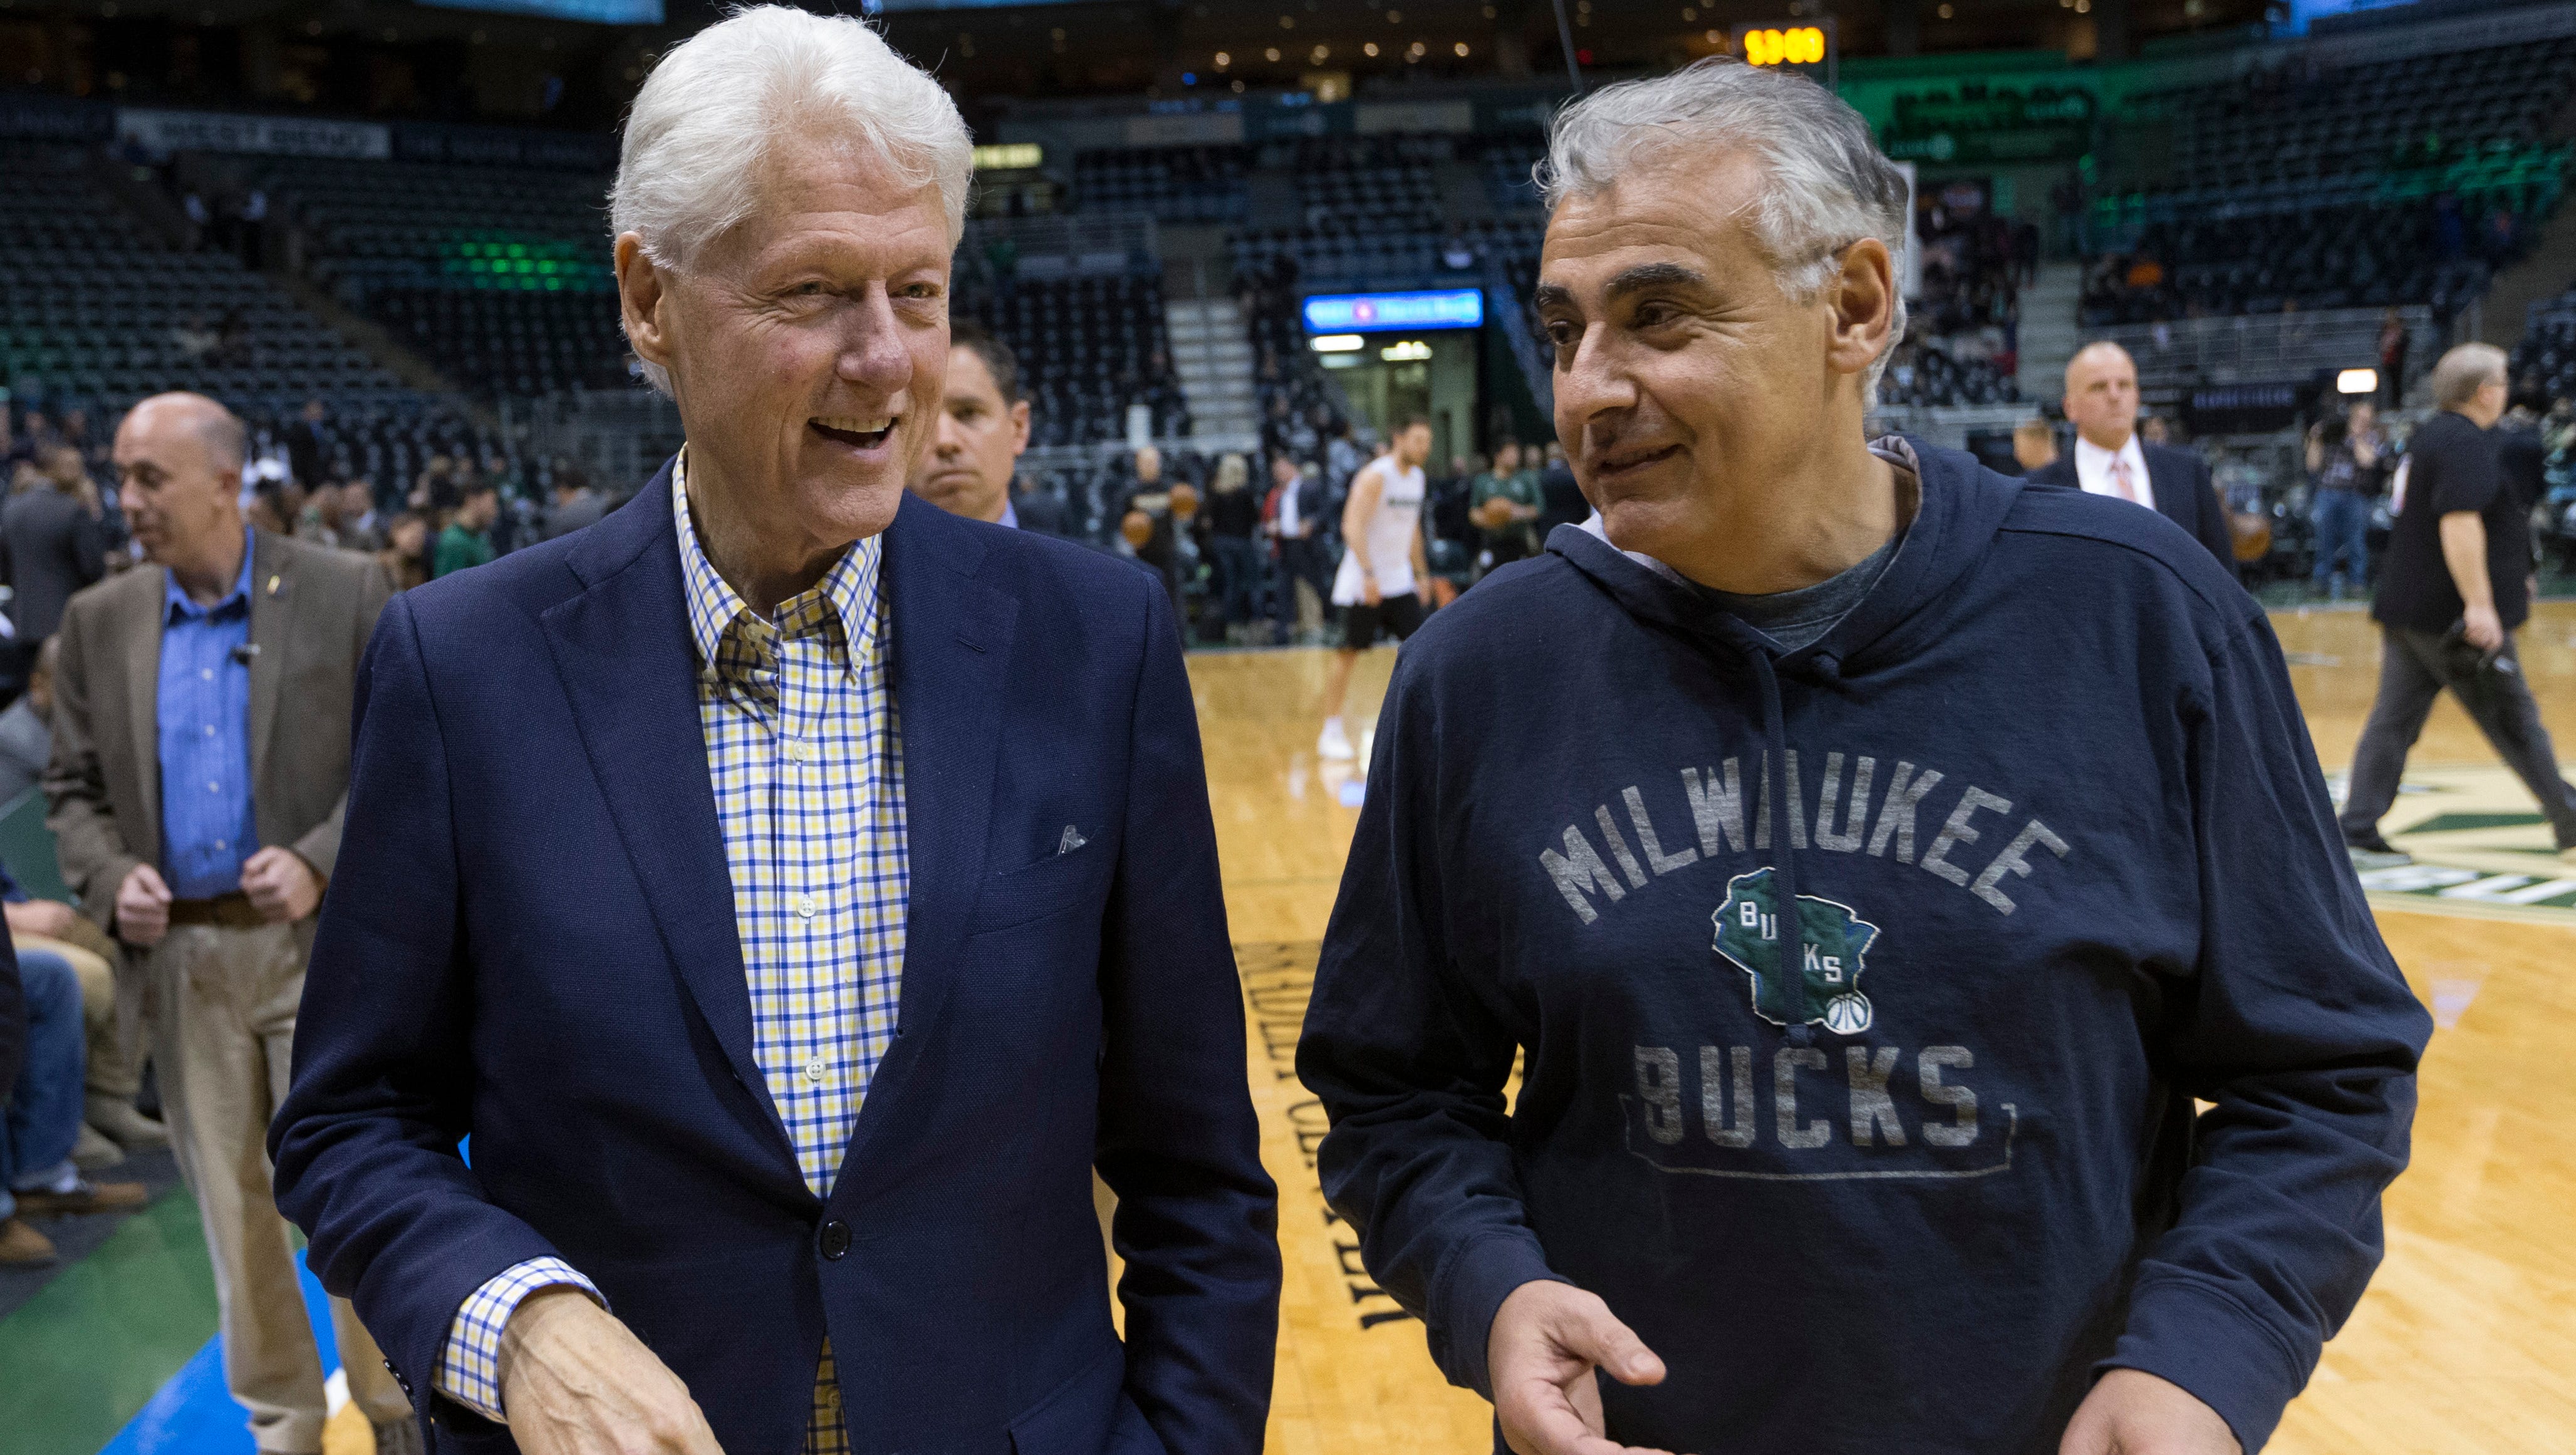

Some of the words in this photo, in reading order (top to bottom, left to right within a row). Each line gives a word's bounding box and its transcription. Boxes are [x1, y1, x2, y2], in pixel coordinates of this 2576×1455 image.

[1538, 749, 2071, 925] MILWAUKEE
[1739, 901, 1844, 983] BUKS
[1634, 1045, 1980, 1149] BUCKS
